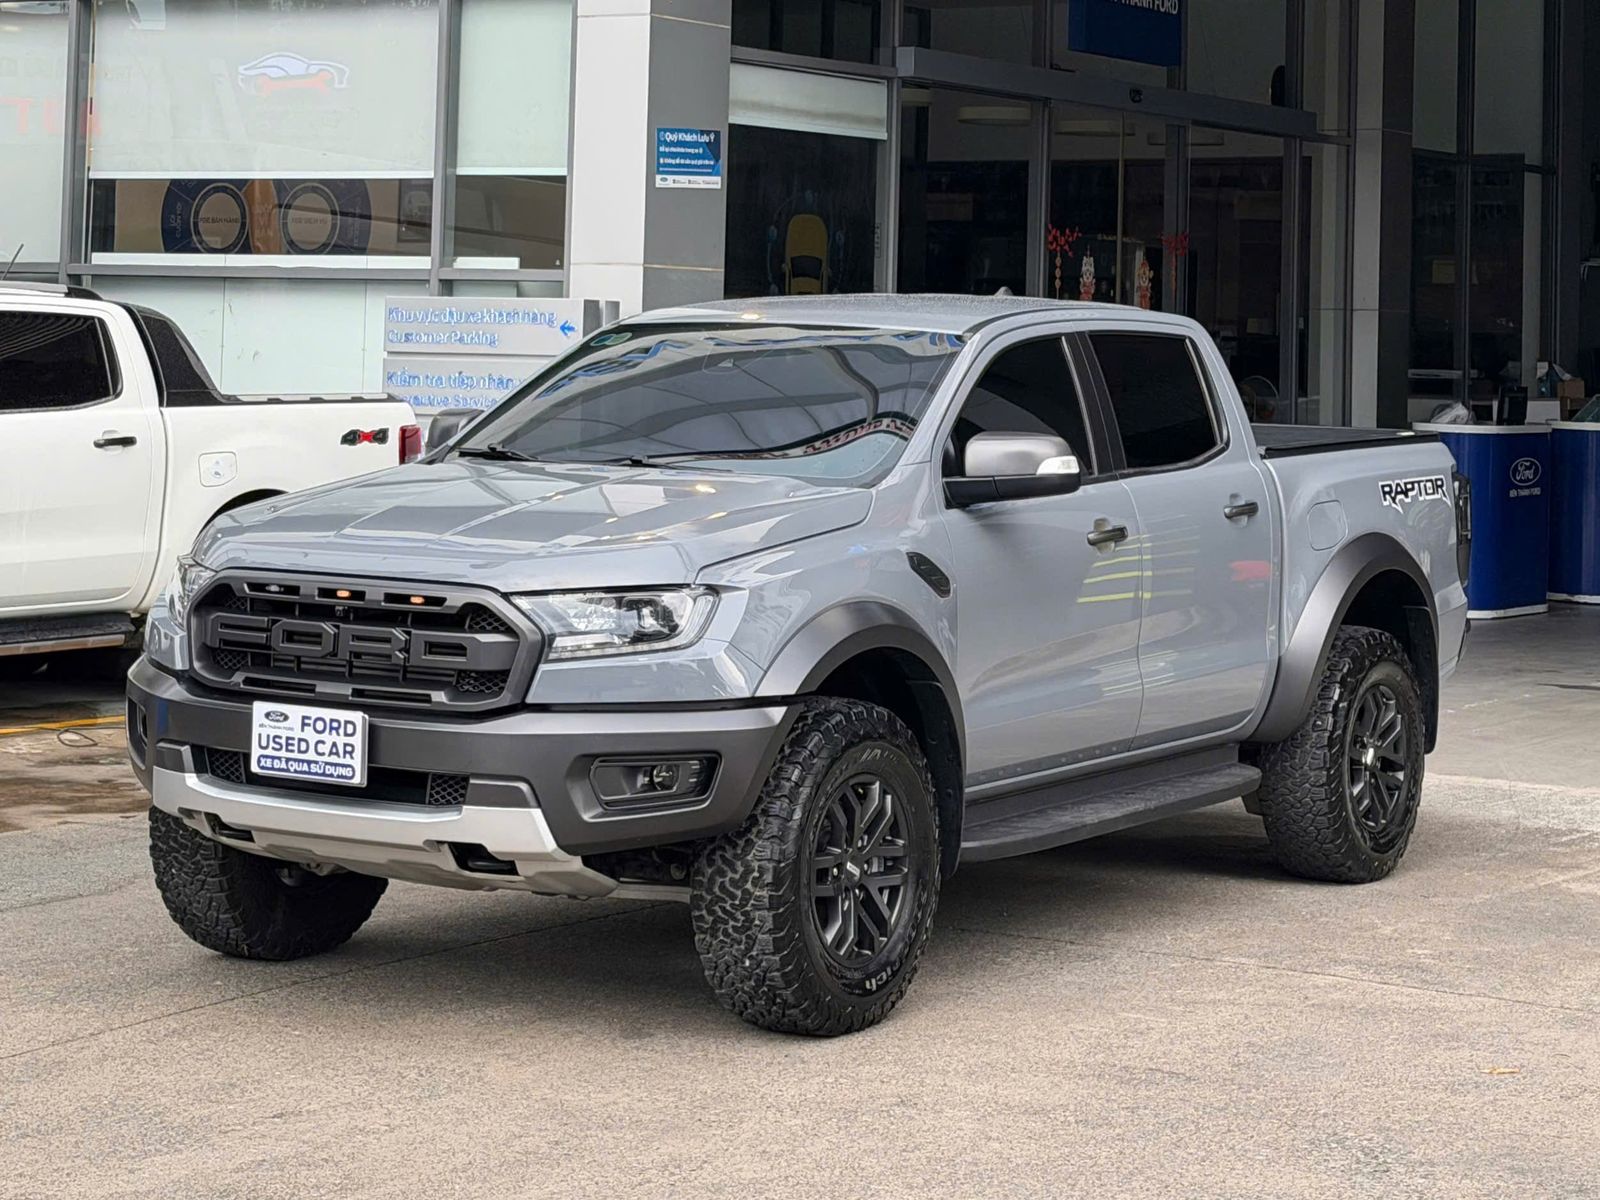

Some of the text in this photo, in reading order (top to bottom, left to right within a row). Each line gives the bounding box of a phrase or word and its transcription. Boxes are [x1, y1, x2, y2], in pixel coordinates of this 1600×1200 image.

[1154, 0, 1178, 14] FORD
[665, 131, 678, 142] Quý
[678, 132, 697, 142] Khách
[389, 306, 414, 323] Khu
[466, 311, 482, 324] xe
[483, 307, 522, 324] khách
[524, 307, 557, 328] hàng
[388, 329, 498, 348] Customer Parking
[387, 366, 423, 387] Kiểm
[427, 373, 446, 388] tra
[449, 370, 477, 391] tiếp
[1379, 475, 1450, 511] RAPTOR
[205, 612, 482, 668] FORD
[300, 714, 357, 738] FORD
[257, 732, 356, 760] USED CAR
[259, 757, 353, 778] XE ĐÃ QUA SỬ DỤNG
